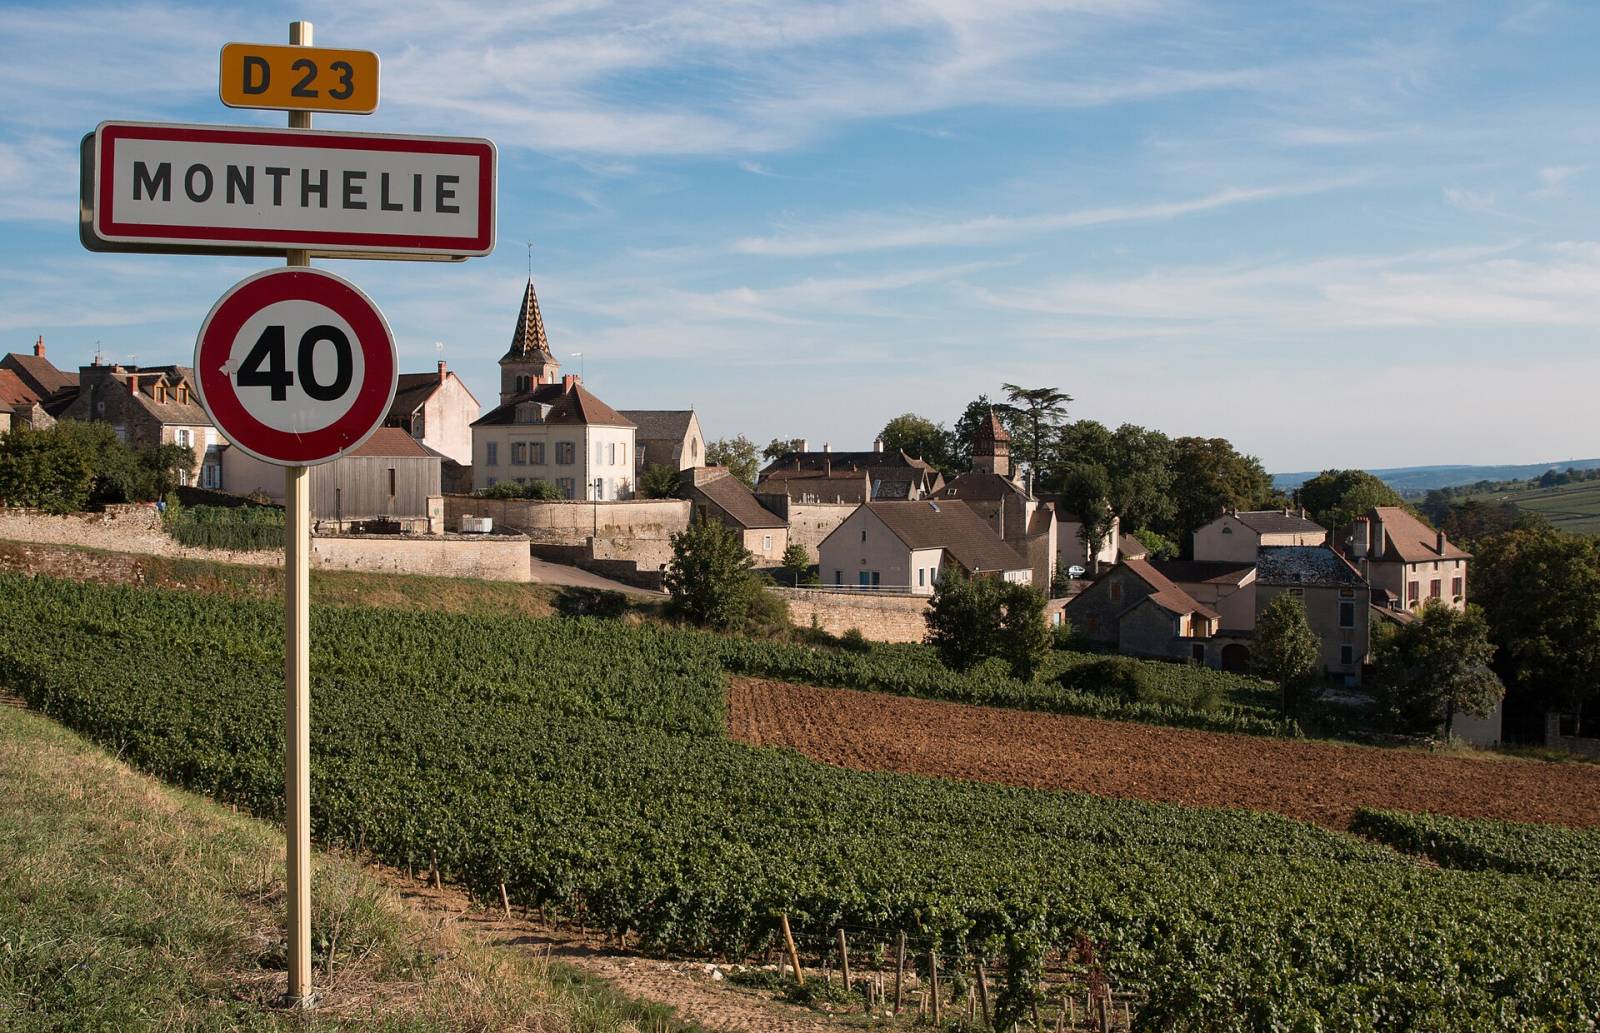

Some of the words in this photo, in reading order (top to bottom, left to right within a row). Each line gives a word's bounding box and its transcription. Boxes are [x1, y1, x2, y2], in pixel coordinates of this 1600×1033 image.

[243, 55, 271, 95] D
[291, 58, 355, 100] 23
[132, 160, 461, 215] MONTHELIE
[236, 325, 353, 402] 40
